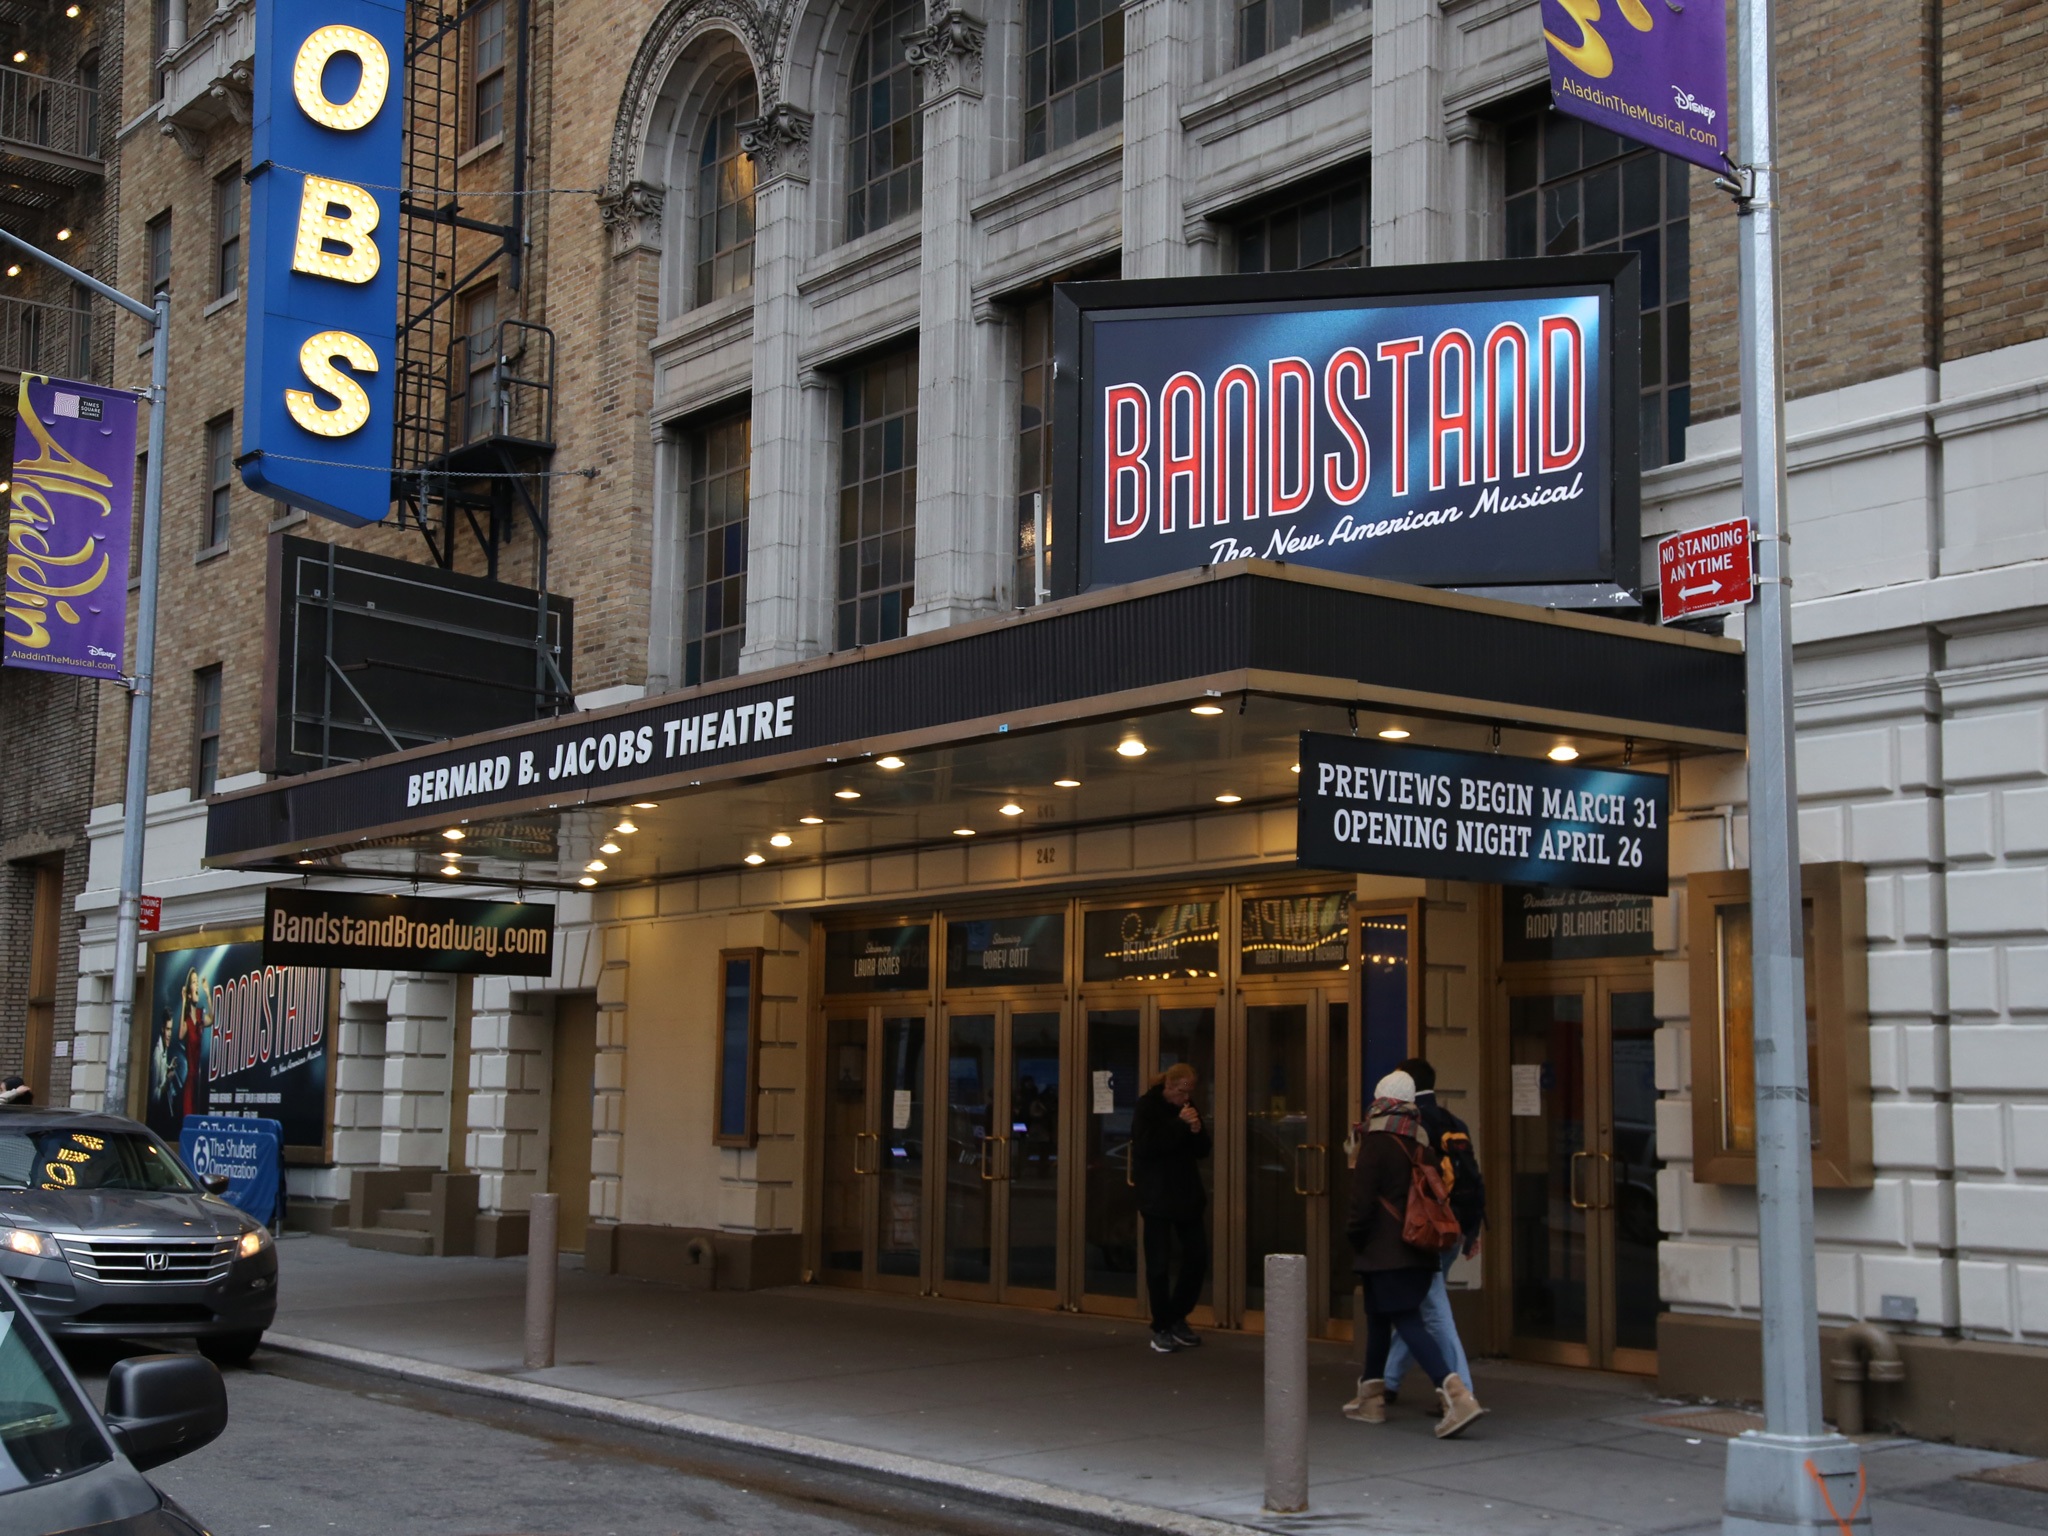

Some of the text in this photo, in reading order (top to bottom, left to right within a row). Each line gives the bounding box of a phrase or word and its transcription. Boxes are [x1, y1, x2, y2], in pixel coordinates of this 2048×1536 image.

[1562, 77, 1718, 147] AladdinTheMusical.com
[83, 401, 100, 409] TIMES
[1104, 313, 1586, 544] BANDSTAND
[1209, 473, 1584, 565] The New American Musical
[1662, 528, 1743, 565] NO STANDING
[1670, 553, 1734, 584] ANYTIME
[11, 651, 116, 670] AladdinTheMusical.com
[407, 696, 796, 807] BERNARD B. JACOBS THEATRE
[1317, 763, 1658, 829] PREVIEWS BEGIN MARCH 31
[1036, 847, 1056, 864] 242
[1333, 809, 1643, 868] OPENING NIGHT APRIL 26
[272, 908, 547, 958] BandstandBroadway.com
[1525, 914, 1558, 939] ANDY
[854, 955, 901, 977] LAURA OSNES
[982, 947, 1029, 970] COREY COTT
[207, 965, 327, 1082] BANDSTAND
[209, 1137, 257, 1160] The Shubert
[208, 1158, 258, 1179] Organization
